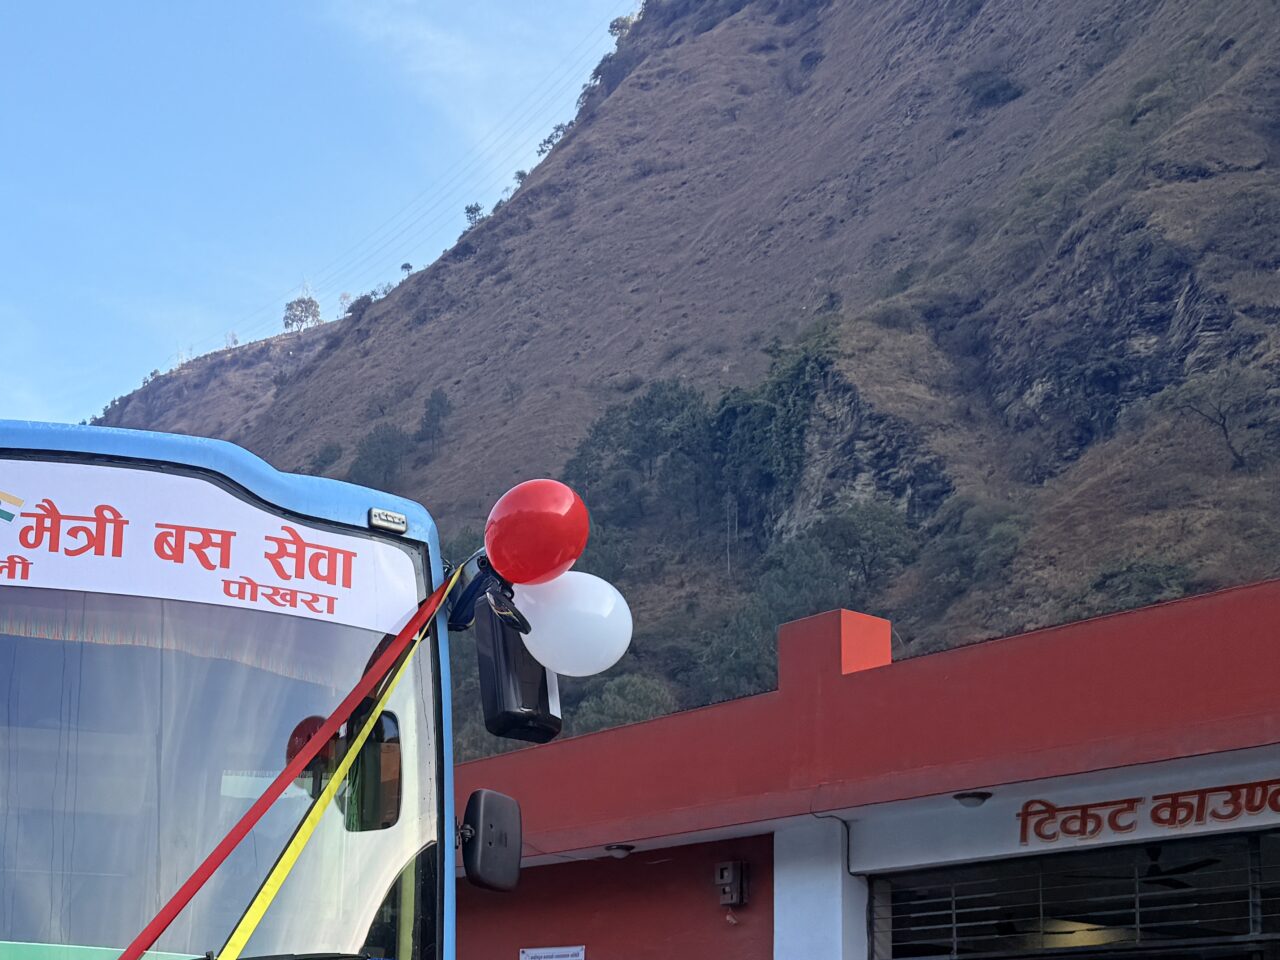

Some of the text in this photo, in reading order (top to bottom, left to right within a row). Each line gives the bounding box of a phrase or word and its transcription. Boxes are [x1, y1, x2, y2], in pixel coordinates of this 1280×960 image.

[18, 498, 129, 562] मैत्री
[154, 523, 235, 570] बस
[265, 525, 357, 588] सेवा
[223, 573, 338, 613] पोखरा
[1016, 797, 1146, 844] टिकट
